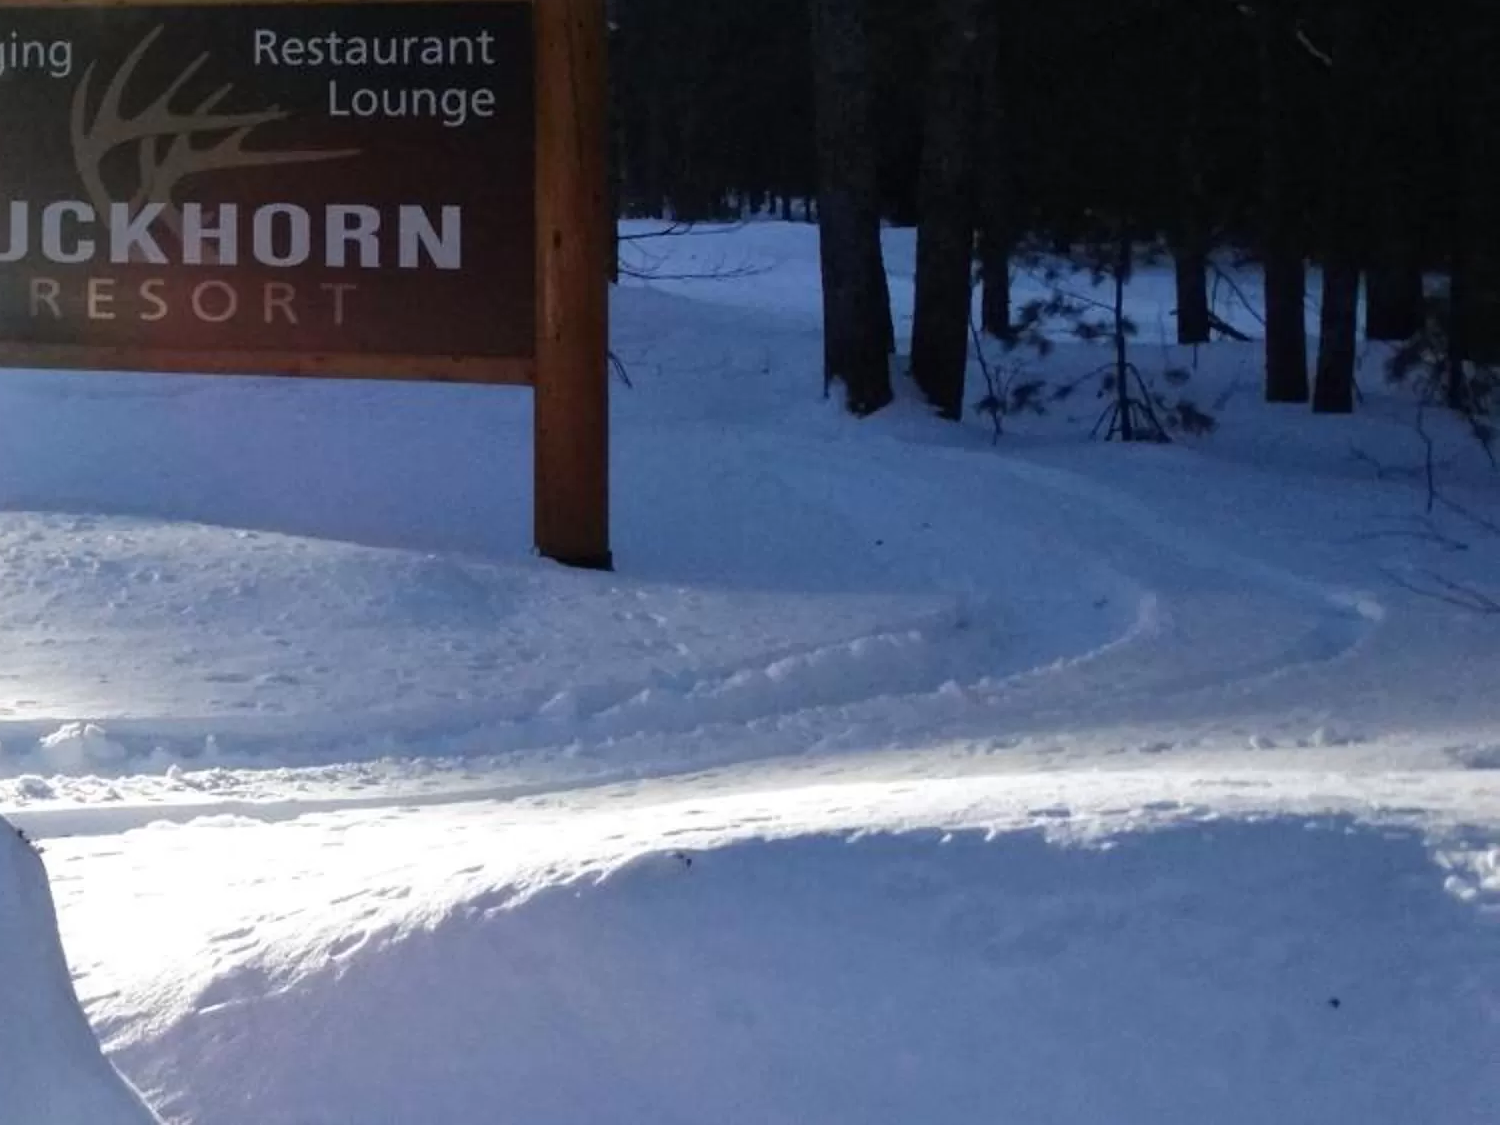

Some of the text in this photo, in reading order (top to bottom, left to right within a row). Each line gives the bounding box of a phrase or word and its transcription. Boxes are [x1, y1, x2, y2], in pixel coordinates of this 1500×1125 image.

[253, 29, 495, 66] Restaurant
[328, 80, 496, 127] Lounge
[30, 278, 357, 325] RESORT
